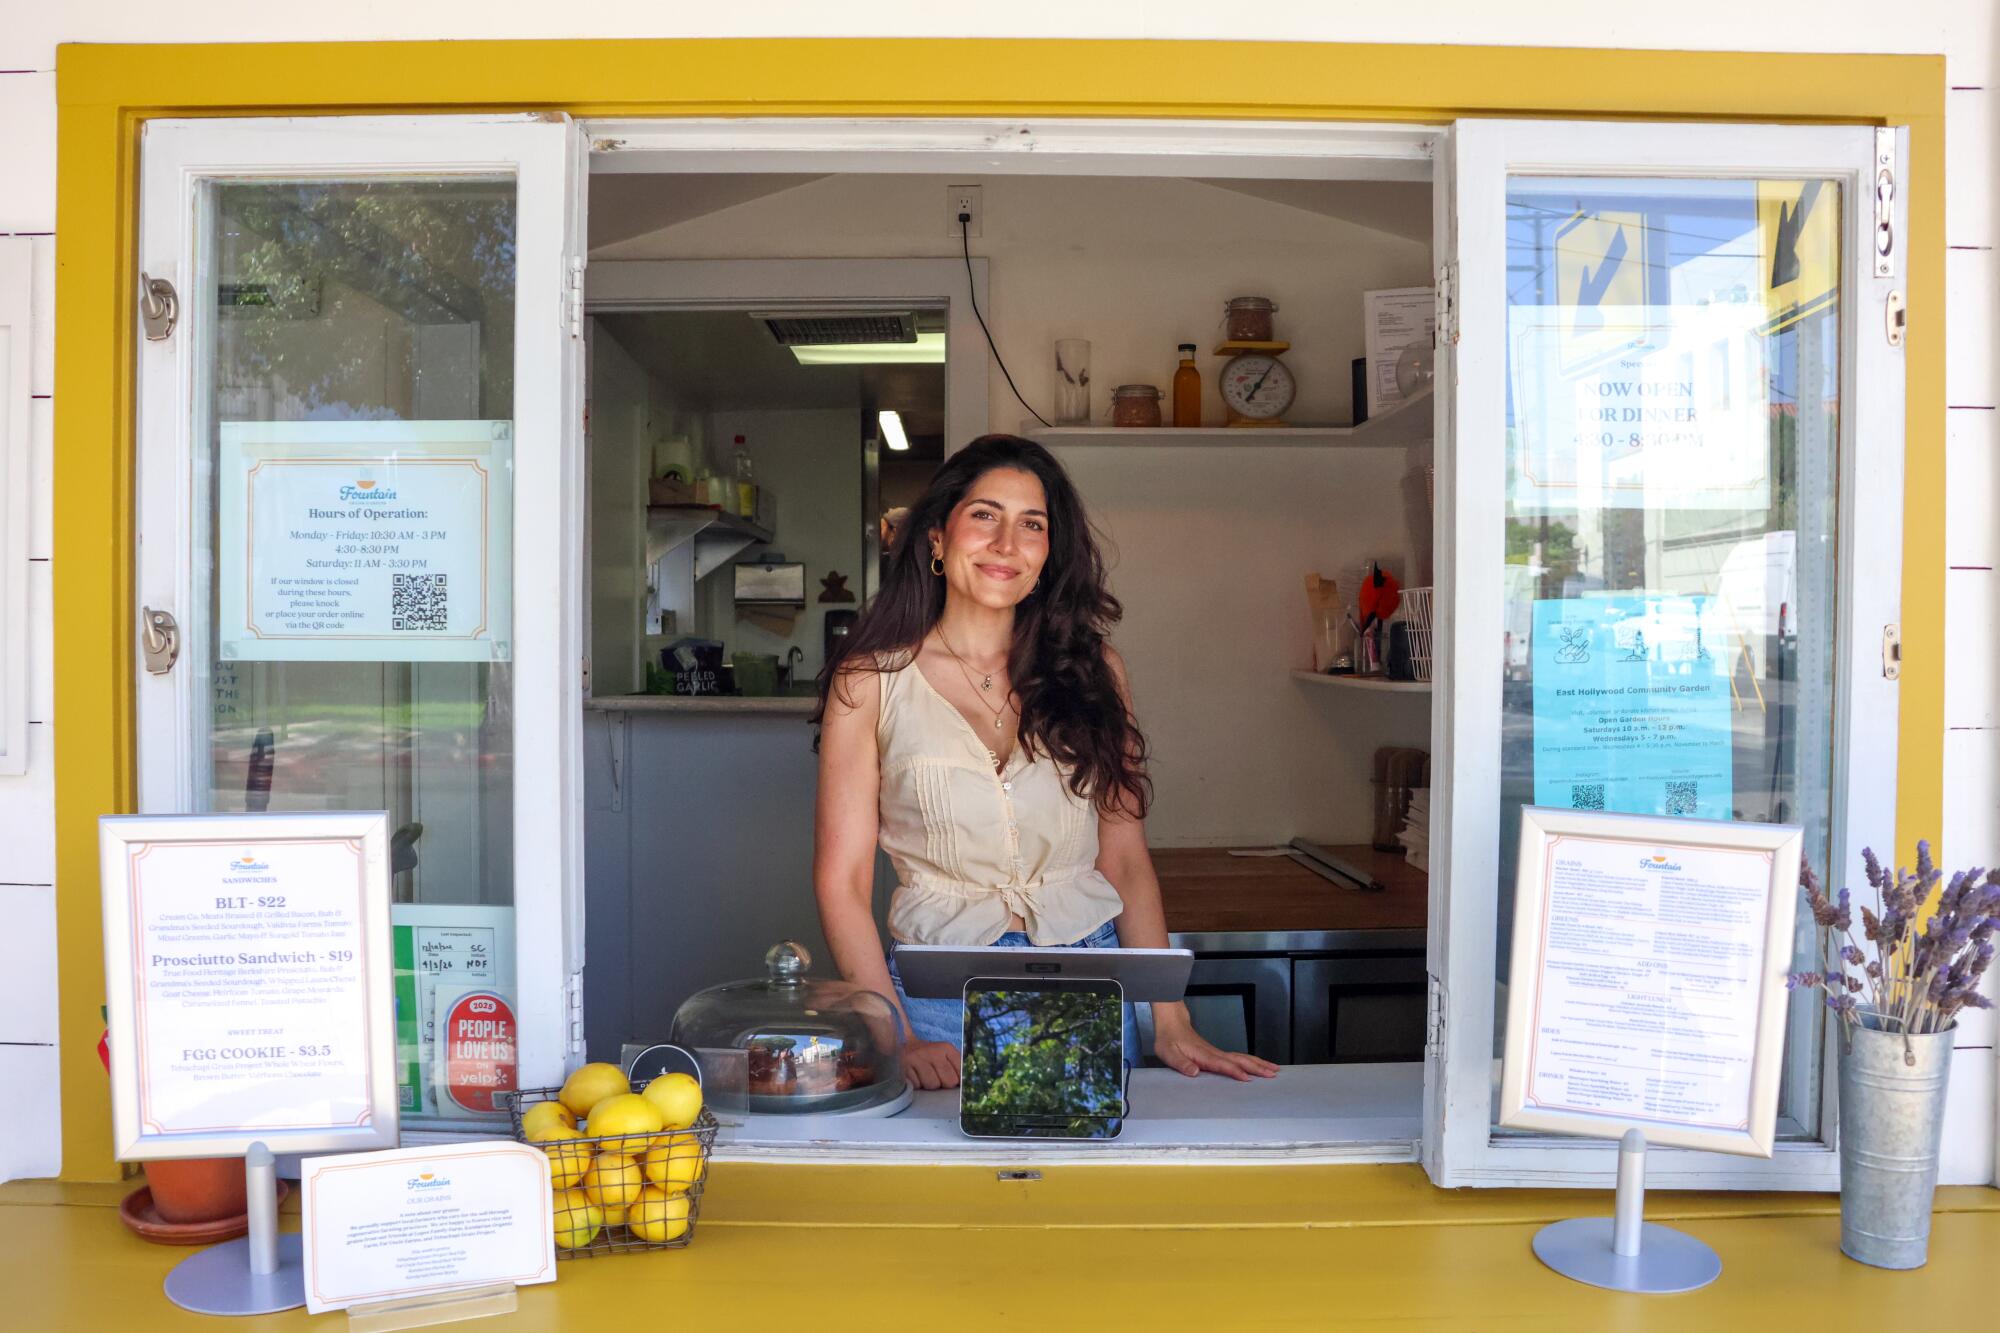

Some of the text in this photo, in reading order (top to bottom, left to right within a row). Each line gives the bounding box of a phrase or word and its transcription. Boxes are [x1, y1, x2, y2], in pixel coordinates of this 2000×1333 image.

[1583, 383, 1692, 396] NOW OPEN
[1578, 408, 1698, 422] FOR DINNER
[340, 486, 397, 501] Fountain
[308, 508, 428, 520] Hours of Operation:
[290, 530, 328, 542] Monday
[336, 530, 368, 542] Friday:
[370, 530, 396, 540] 10:30
[397, 530, 414, 540] AM
[422, 530, 428, 540] 3
[430, 530, 446, 540] PM
[335, 544, 399, 554] 4:30-8:30 PM
[306, 558, 352, 570] Saturday:
[354, 559, 362, 568] 11
[363, 559, 380, 568] AM
[388, 559, 410, 568] 3:30
[412, 559, 428, 568] PM
[294, 578, 324, 586] window
[326, 578, 332, 586] is
[334, 578, 358, 586] closed
[278, 588, 304, 598] during
[306, 588, 326, 596] these
[290, 600, 340, 608] please knock
[276, 610, 296, 620] place
[298, 612, 316, 620] your
[318, 610, 339, 618] order
[340, 610, 364, 618] online
[285, 621, 344, 630] via the QR code
[677, 671, 716, 680] PEELED
[676, 681, 718, 692] GARLIC
[1556, 684, 1710, 698] East Hollywood Community Garden
[1598, 717, 1618, 725] Open
[1584, 726, 1620, 735] Saturdays
[1592, 734, 1638, 744] Wednesdays
[1660, 734, 1676, 742] p.m.
[230, 861, 270, 871] Fountain
[1640, 858, 1682, 872] Fountain
[222, 876, 278, 884] SANDWICHES
[258, 896, 286, 908] $22
[470, 944, 486, 952] SC
[152, 954, 234, 967] Prosciutto
[238, 951, 316, 965] Sandwich
[328, 950, 353, 962] $19
[473, 1002, 493, 1010] 2025
[258, 1028, 284, 1036] TREAT
[458, 1019, 506, 1039] PEOPLE
[1542, 1027, 1560, 1035] SIDES
[182, 1048, 216, 1060] FGG
[220, 1046, 286, 1060] COOKIE
[298, 1044, 332, 1058] $3.5
[456, 1041, 509, 1060] LOVE US
[460, 1072, 492, 1086] yelp
[1538, 1071, 1564, 1081] DRINKS
[408, 1177, 452, 1190] Fountain
